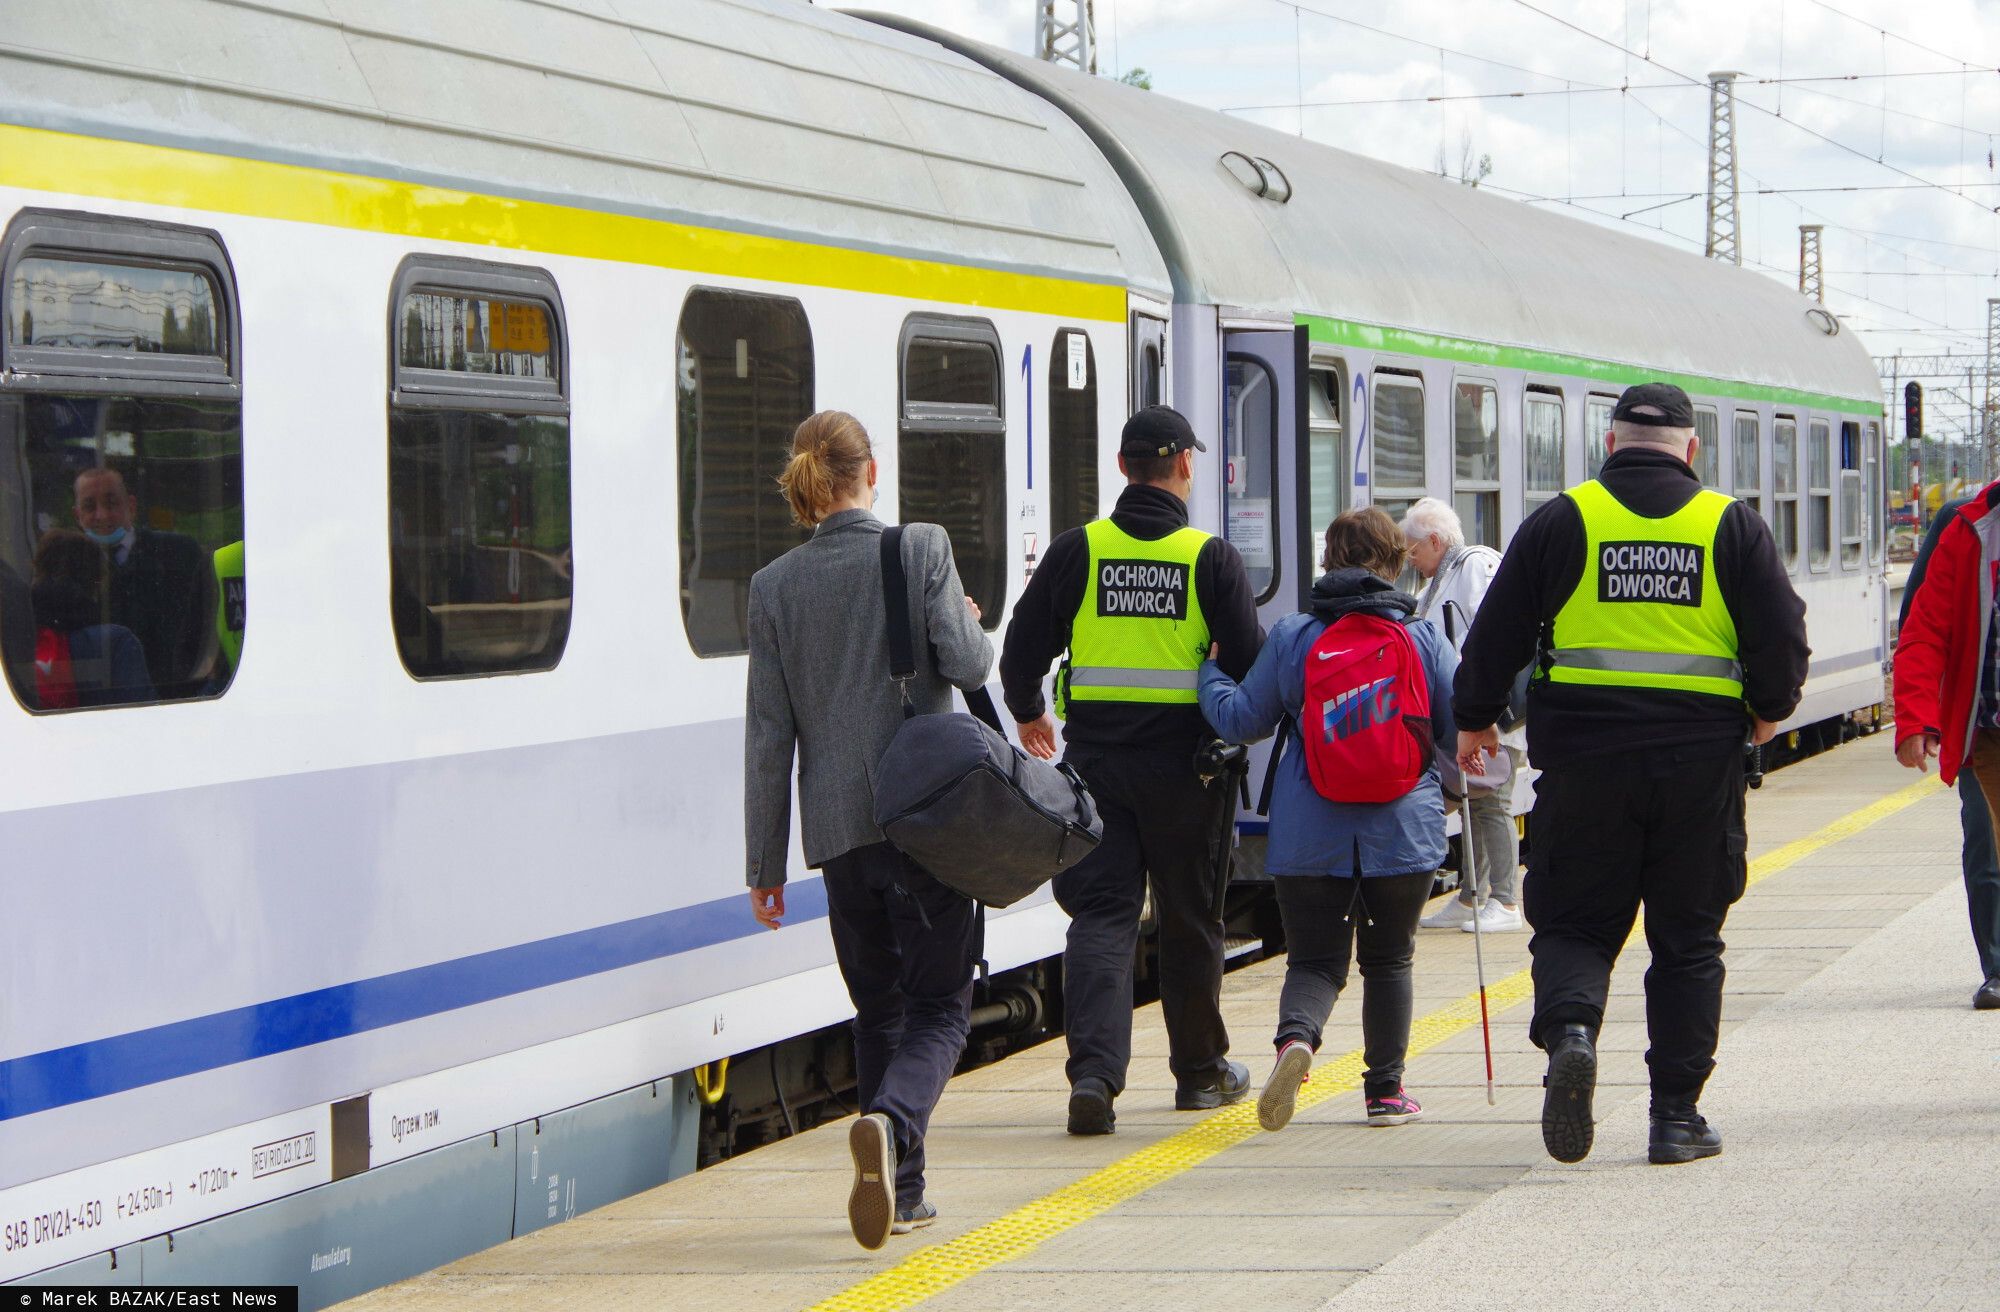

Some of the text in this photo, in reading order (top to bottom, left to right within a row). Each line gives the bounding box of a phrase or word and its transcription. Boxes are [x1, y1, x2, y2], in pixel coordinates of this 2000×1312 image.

[1022, 344, 1033, 490] 1
[1353, 372, 1368, 486] 2
[1602, 546, 1698, 573] OCHRONA
[1101, 565, 1183, 590] OCHRONA
[1607, 574, 1691, 600] DWORCA
[1106, 590, 1176, 615] DWORCA
[1322, 674, 1400, 745] NIKE
[5, 1200, 102, 1251] SAB DRV2A-450
[310, 1245, 351, 1273] Akumulatory
